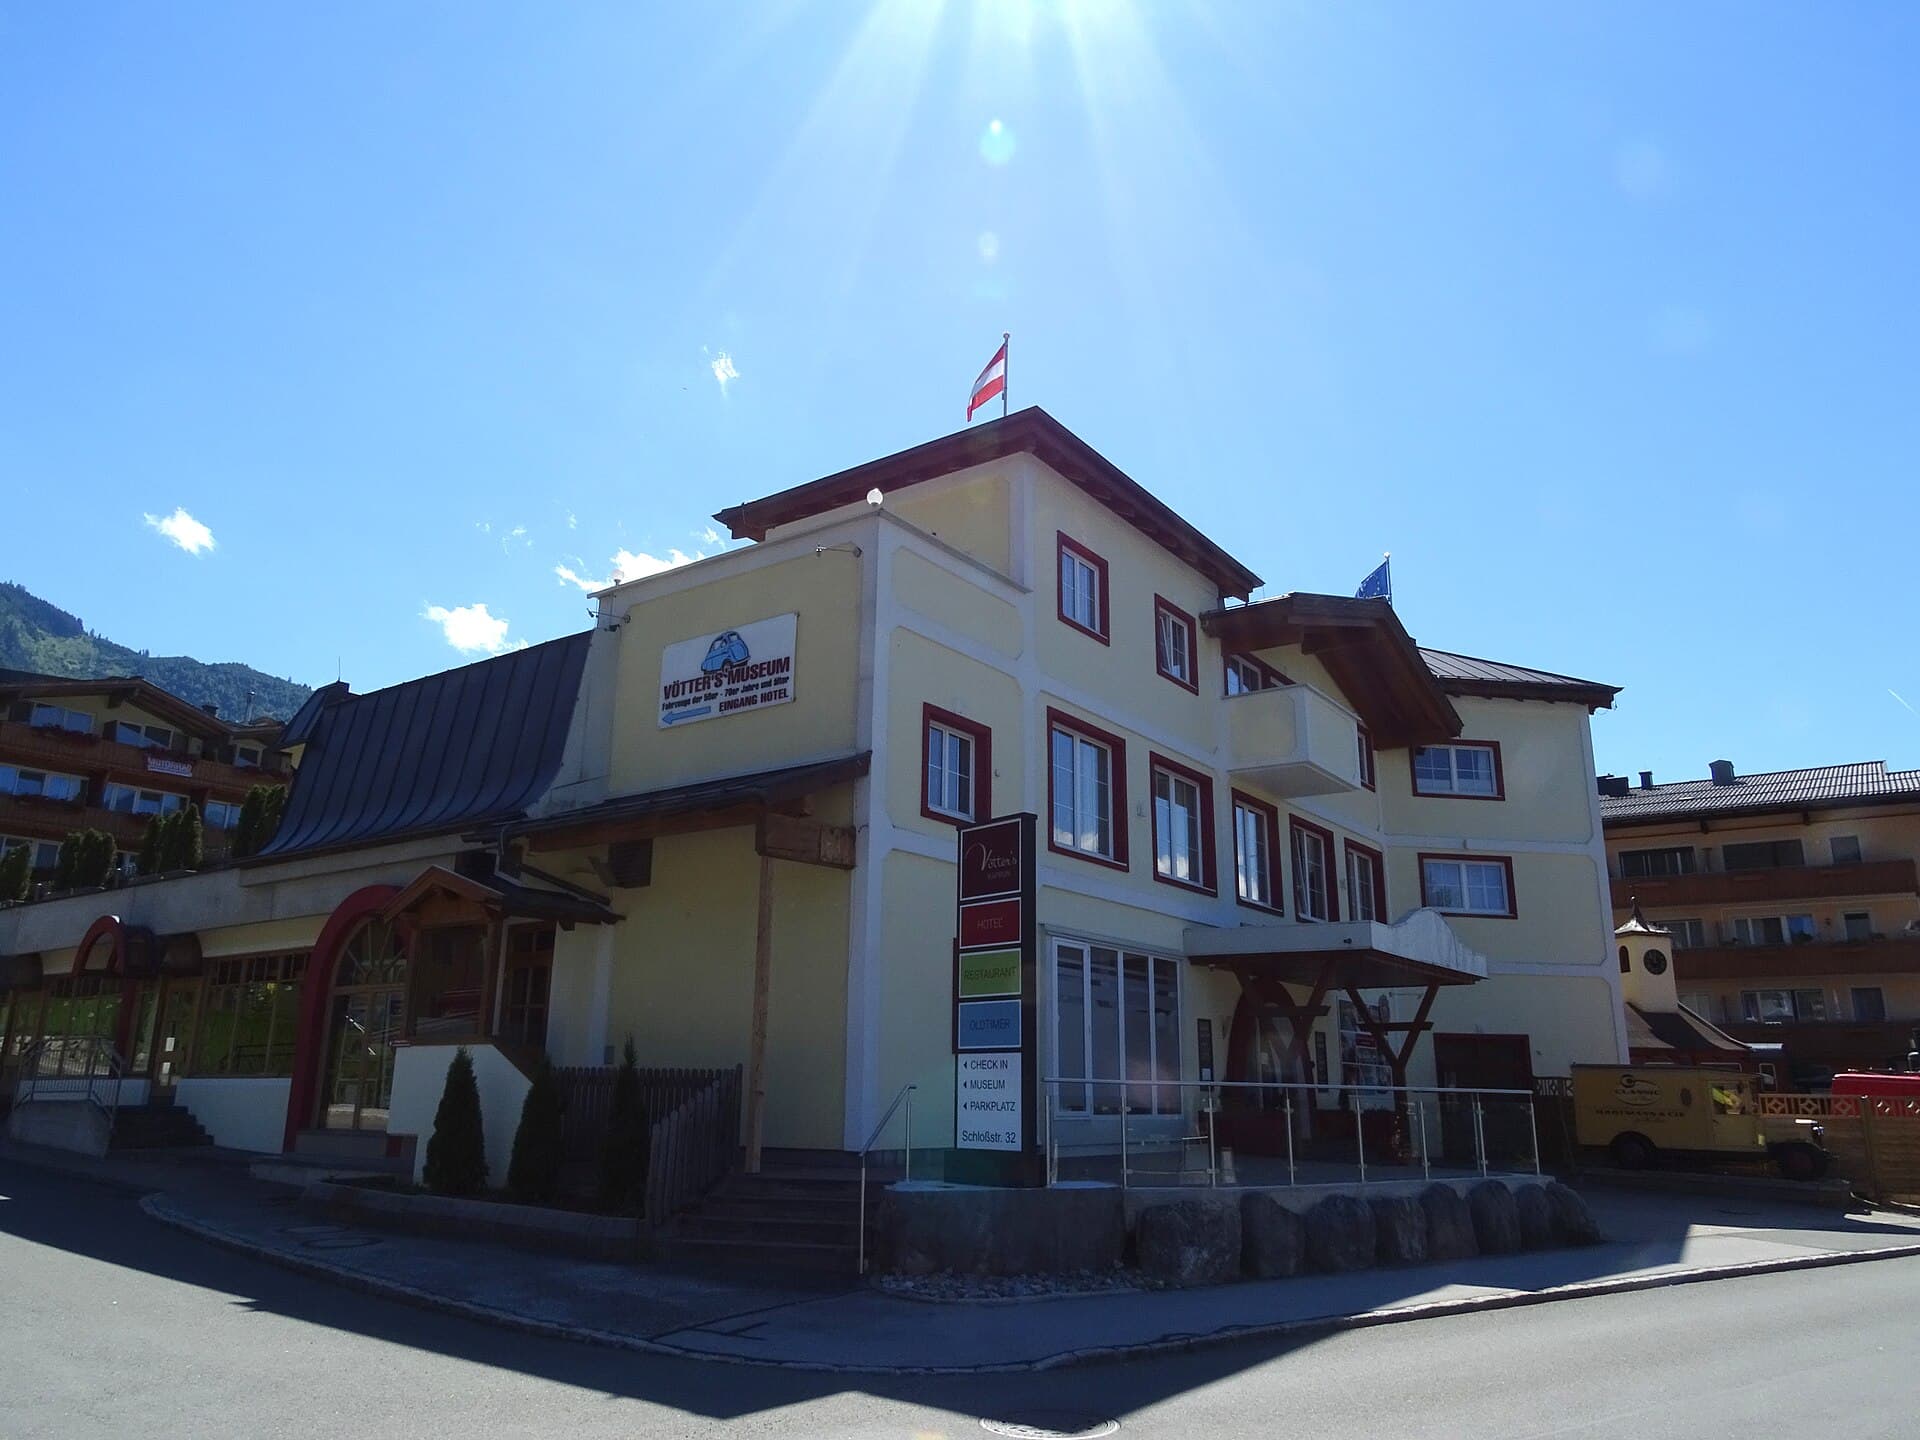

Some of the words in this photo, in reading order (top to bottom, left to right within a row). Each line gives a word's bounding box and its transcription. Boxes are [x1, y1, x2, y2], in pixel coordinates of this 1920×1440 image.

[664, 672, 723, 699] VÖTTER'S
[728, 656, 790, 684] MUSEUM
[719, 694, 758, 712] EINGANG
[760, 688, 789, 703] HOTEL
[977, 918, 1004, 930] HOTEL
[964, 966, 1017, 980] RESTAURANT
[969, 1018, 1010, 1031] OLDTIMER
[970, 1060, 998, 1070] CHECK
[1000, 1060, 1008, 1069] IN
[970, 1079, 1005, 1089] MUSEUM
[970, 1101, 1016, 1112] PARKPLATZ
[962, 1130, 1002, 1143] Schloßstr.
[1005, 1131, 1016, 1144] 32
